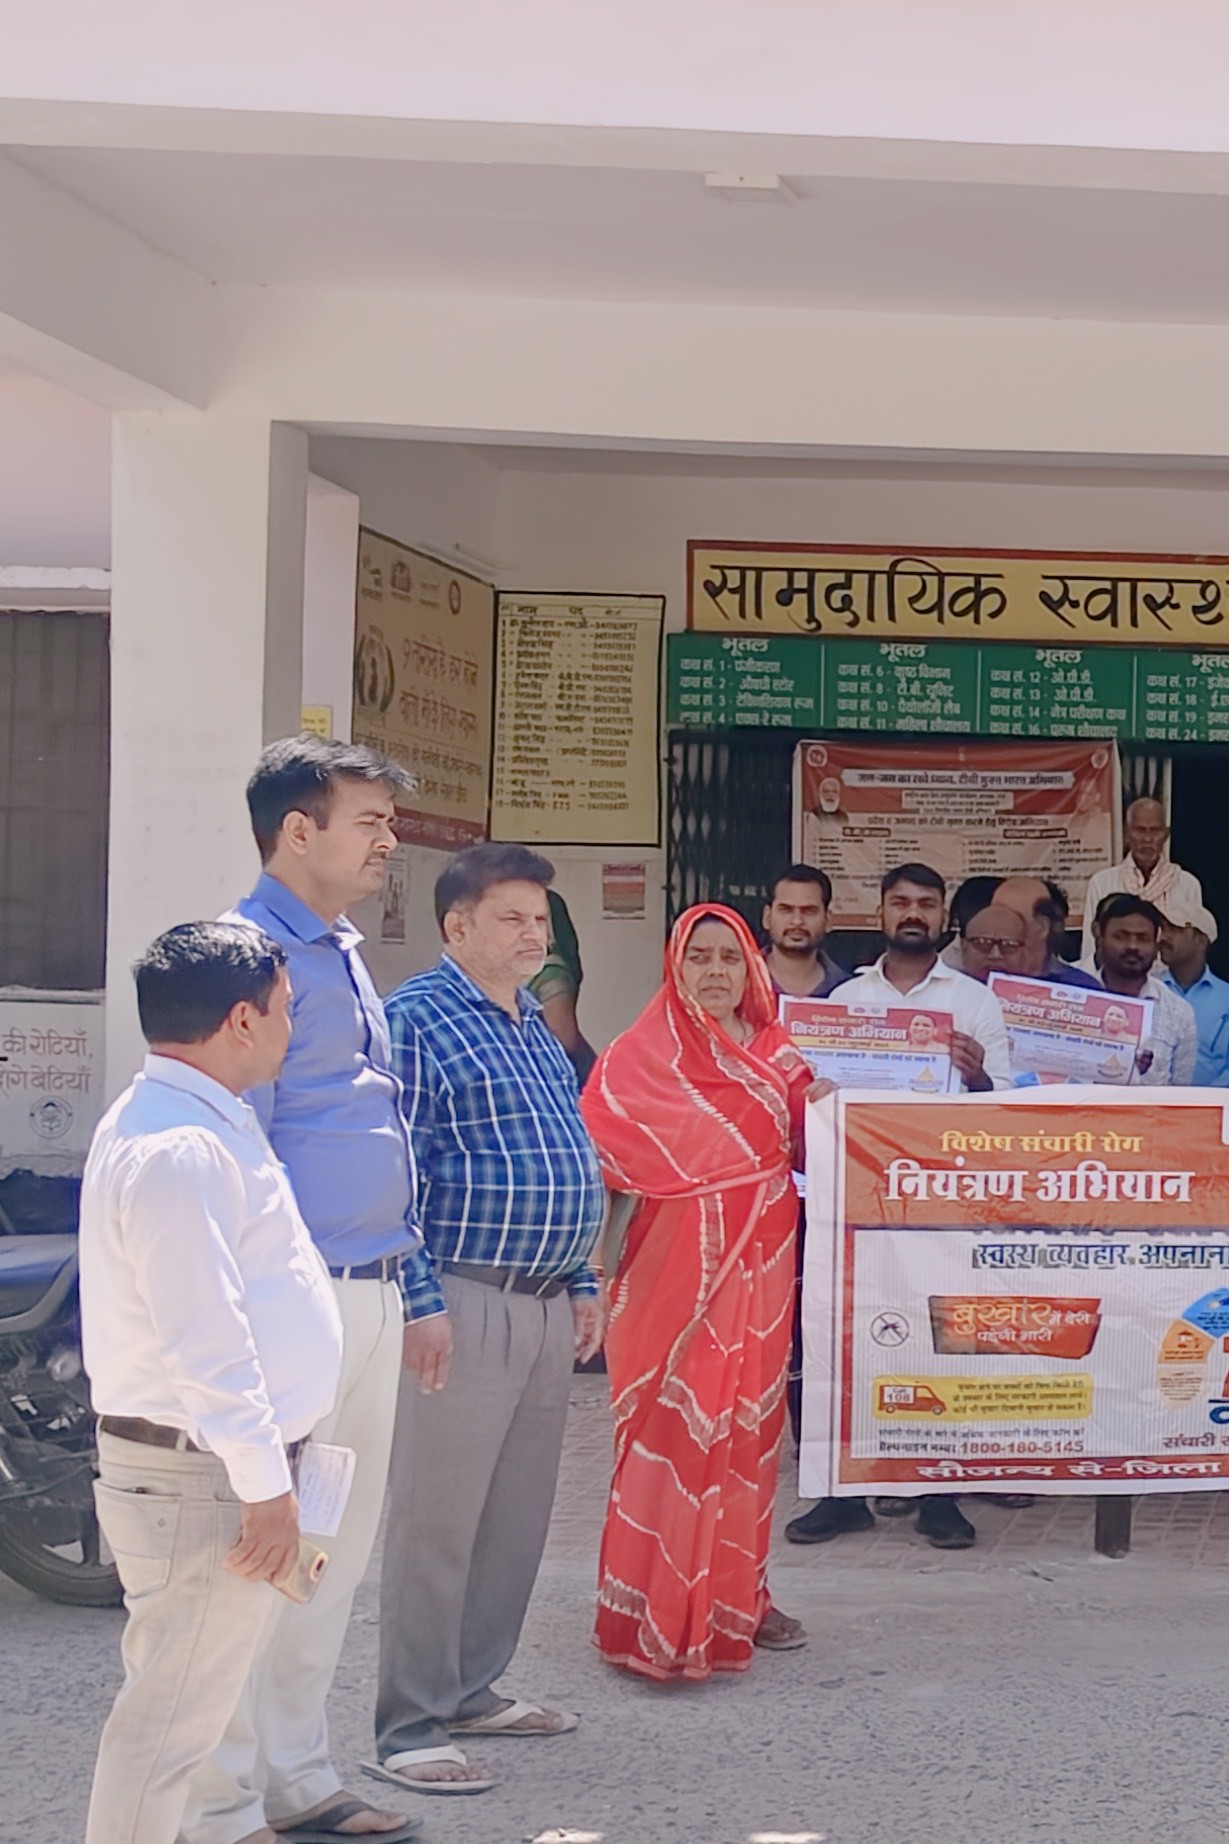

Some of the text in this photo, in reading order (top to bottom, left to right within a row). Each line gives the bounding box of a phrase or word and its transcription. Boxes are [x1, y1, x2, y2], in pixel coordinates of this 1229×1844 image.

[703, 558, 1006, 632] सामुदायिक
[722, 638, 769, 656] भूतल
[880, 643, 927, 662] भूतल
[1035, 649, 1083, 668] भूतल
[1030, 671, 1040, 683] 12
[1186, 677, 1197, 687] 17
[1029, 707, 1039, 718] 14
[1184, 729, 1197, 740] 24
[3, 1027, 26, 1054] की
[848, 1025, 907, 1040] अभियान
[939, 1129, 1143, 1153] विशेष संचारी रोग
[884, 1156, 1195, 1202] नियंत्रण अभियान
[953, 1300, 1051, 1335] बुखार
[1020, 1327, 1052, 1341] भारी
[961, 1441, 1084, 1454] 1800-180-5145
[1163, 1433, 1215, 1449] संचारी
[916, 1460, 1054, 1479] सौजन्य
